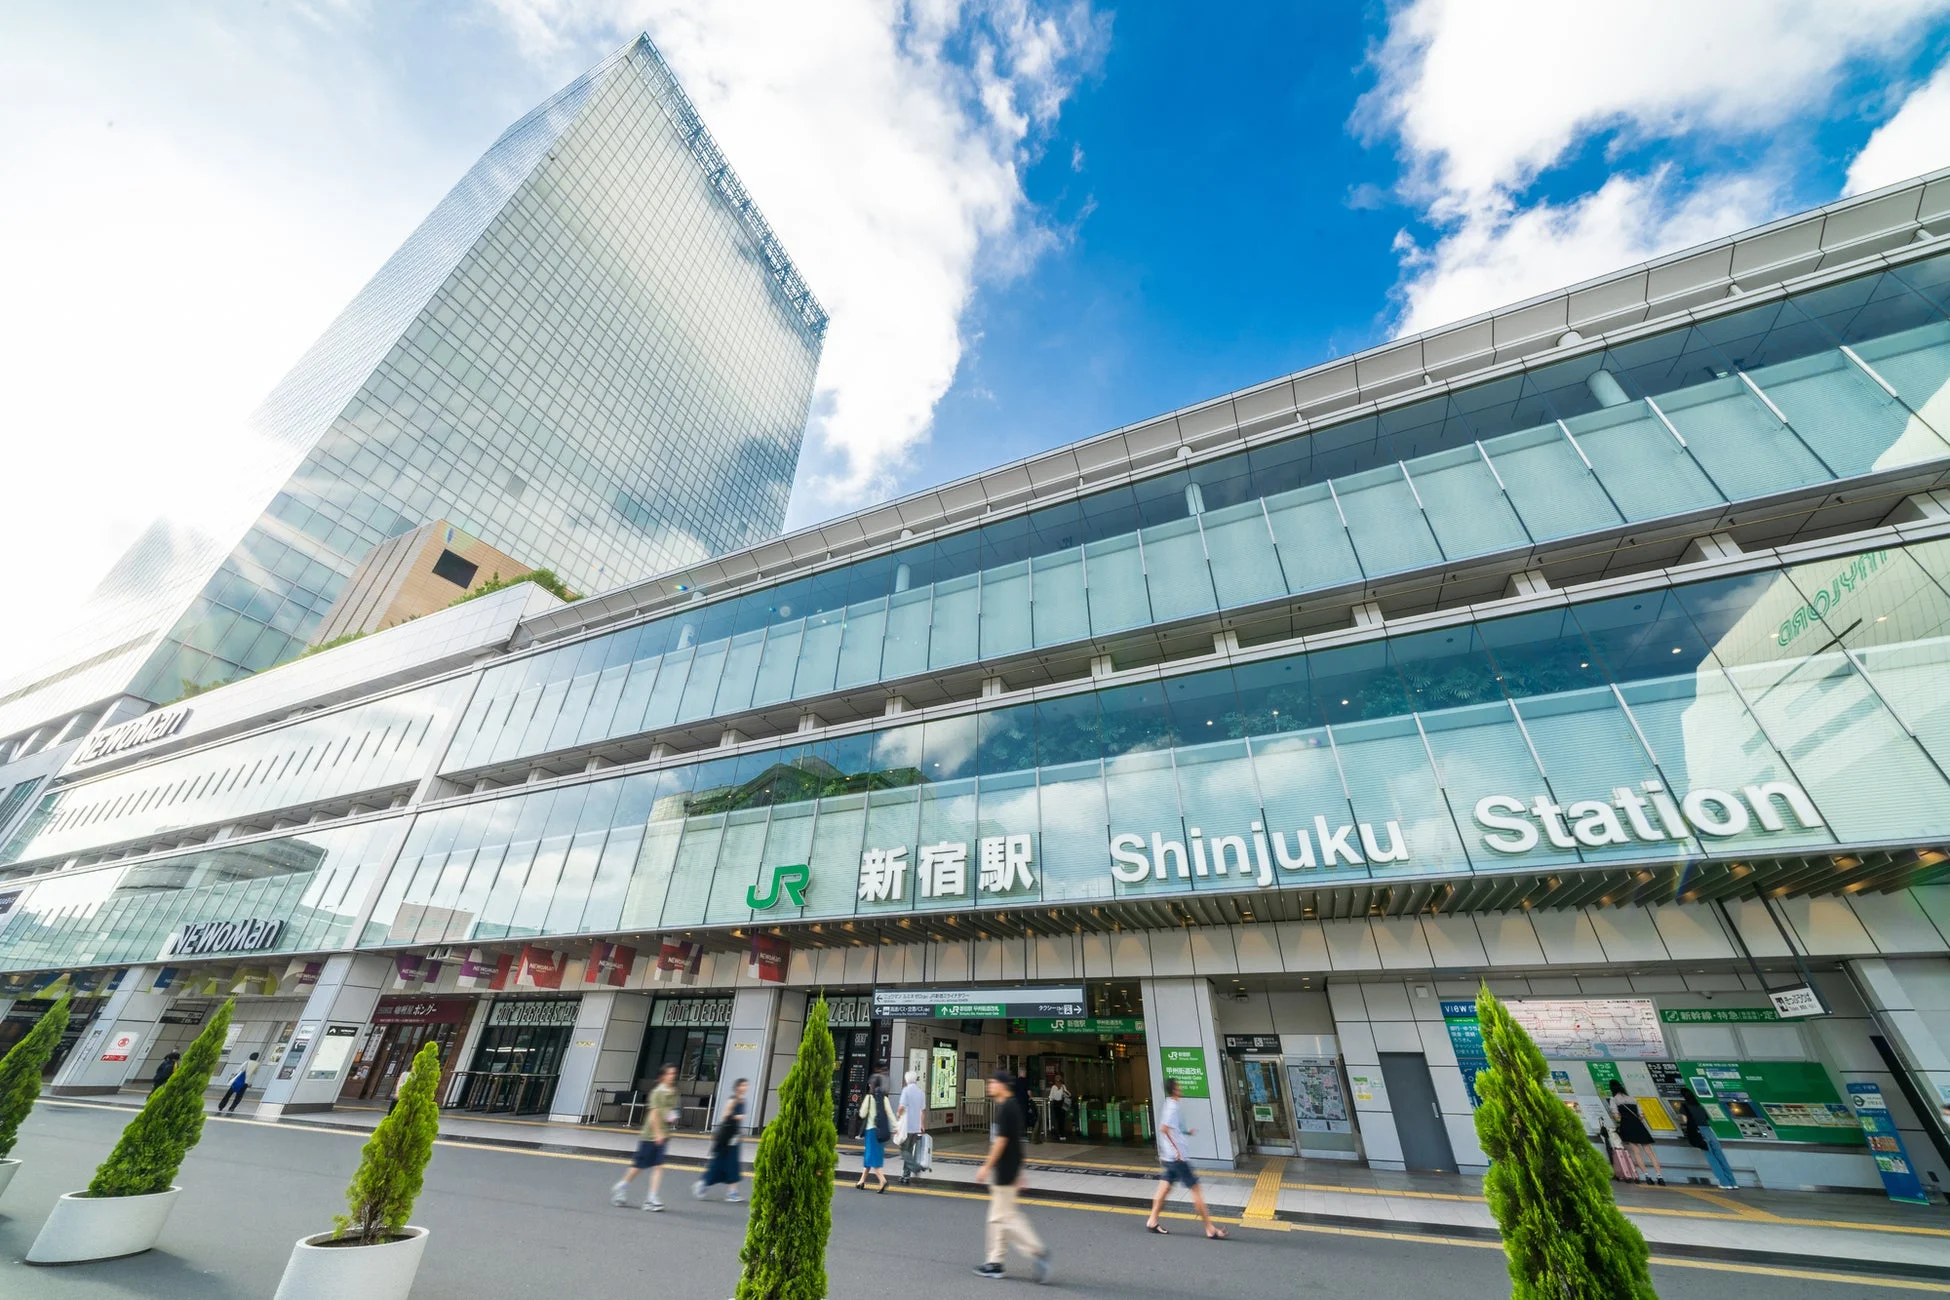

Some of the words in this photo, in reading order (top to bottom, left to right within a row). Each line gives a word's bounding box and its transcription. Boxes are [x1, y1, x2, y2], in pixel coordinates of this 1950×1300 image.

[1110, 815, 1409, 887] Shinjuku
[1473, 780, 1823, 853] Station
[746, 863, 812, 909] JR
[857, 833, 1034, 902] 新宿駅
[515, 1006, 560, 1022] DEGREES
[1051, 1019, 1065, 1028] JR
